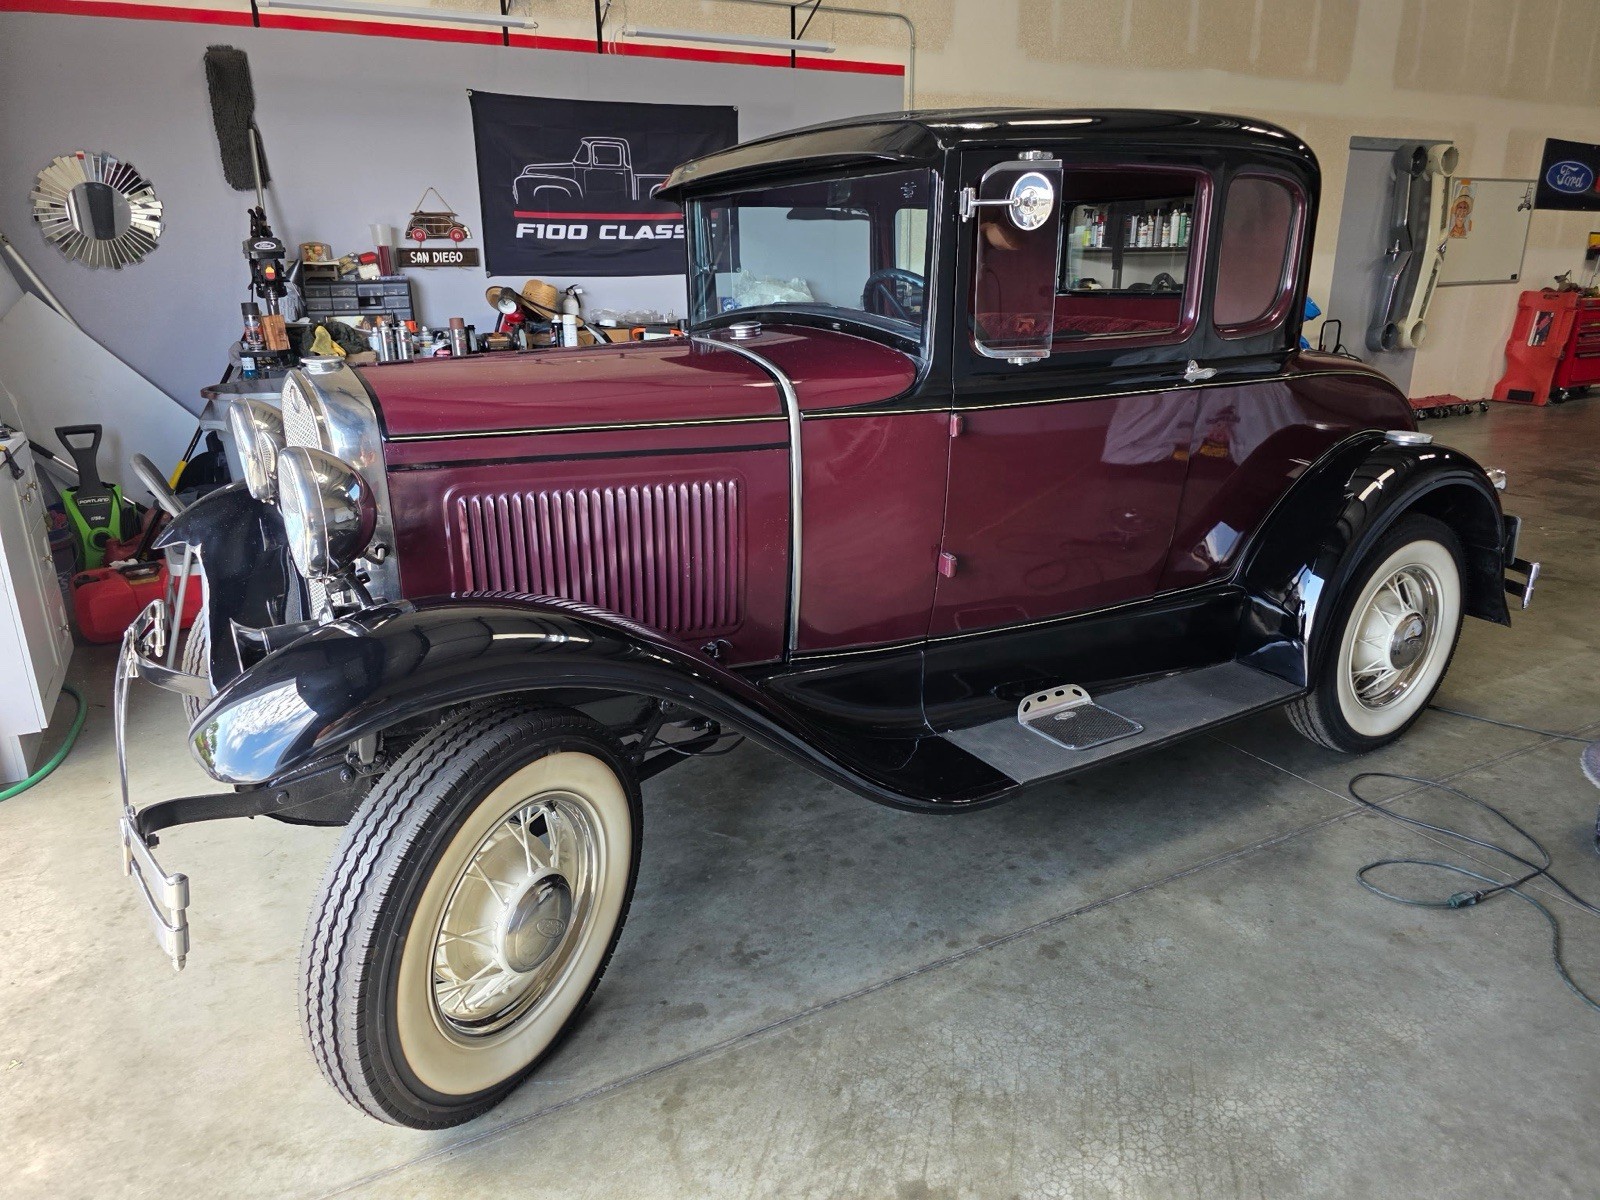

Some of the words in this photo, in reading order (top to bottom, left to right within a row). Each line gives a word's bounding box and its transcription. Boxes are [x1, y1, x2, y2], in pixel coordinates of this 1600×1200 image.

[1556, 164, 1585, 188] Ford
[516, 223, 588, 240] F100
[599, 224, 685, 240] CLASS
[410, 251, 429, 263] SAN
[432, 251, 463, 264] DIEGO
[79, 497, 110, 505] PORTLAND
